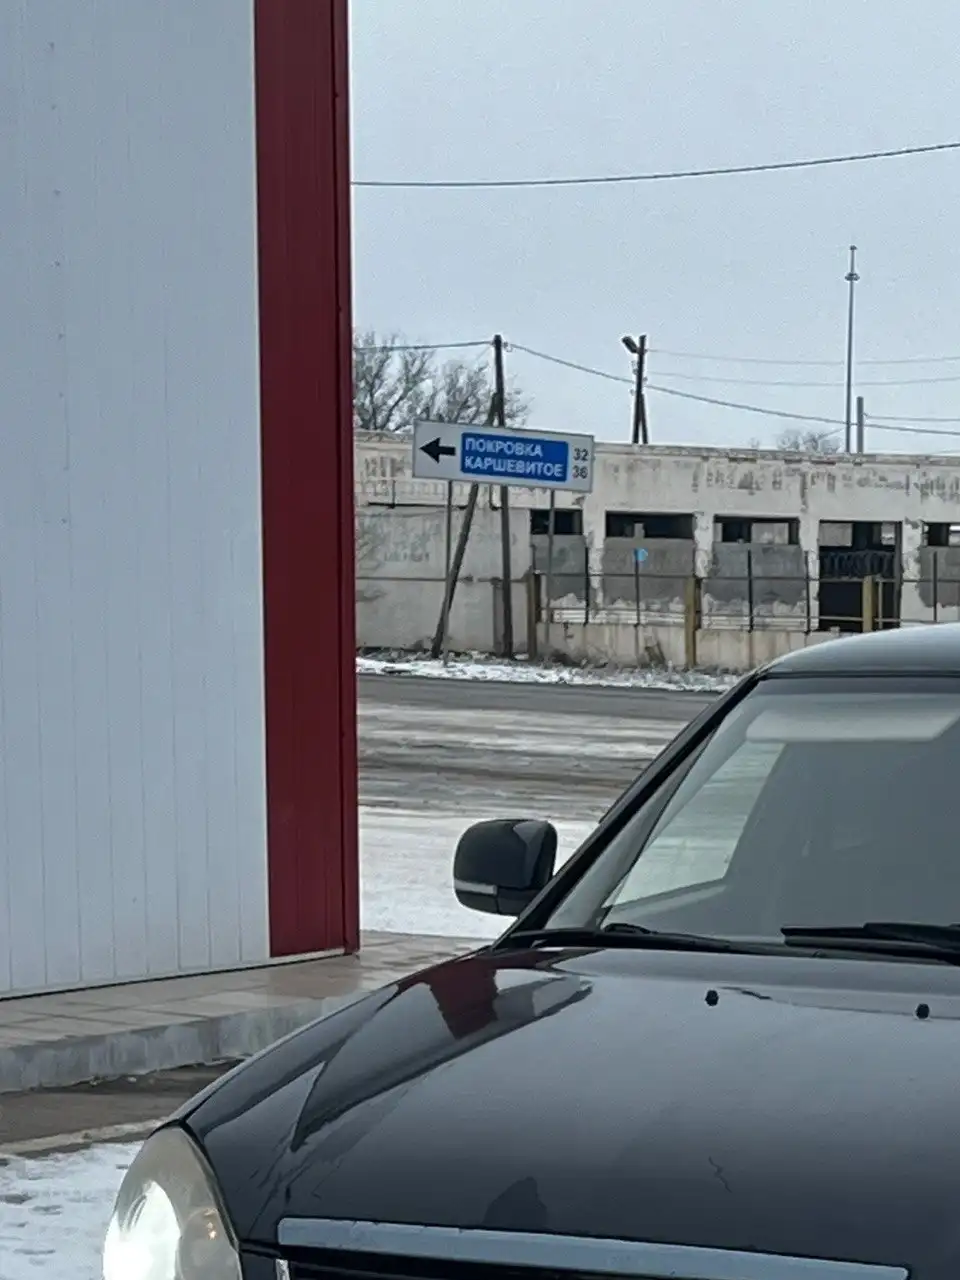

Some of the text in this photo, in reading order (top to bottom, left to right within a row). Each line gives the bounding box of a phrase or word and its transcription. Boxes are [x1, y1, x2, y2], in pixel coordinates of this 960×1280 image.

[465, 438, 589, 462] ПОКРОВКА 32
[465, 456, 564, 478] КАРШЕВИТОЕ
